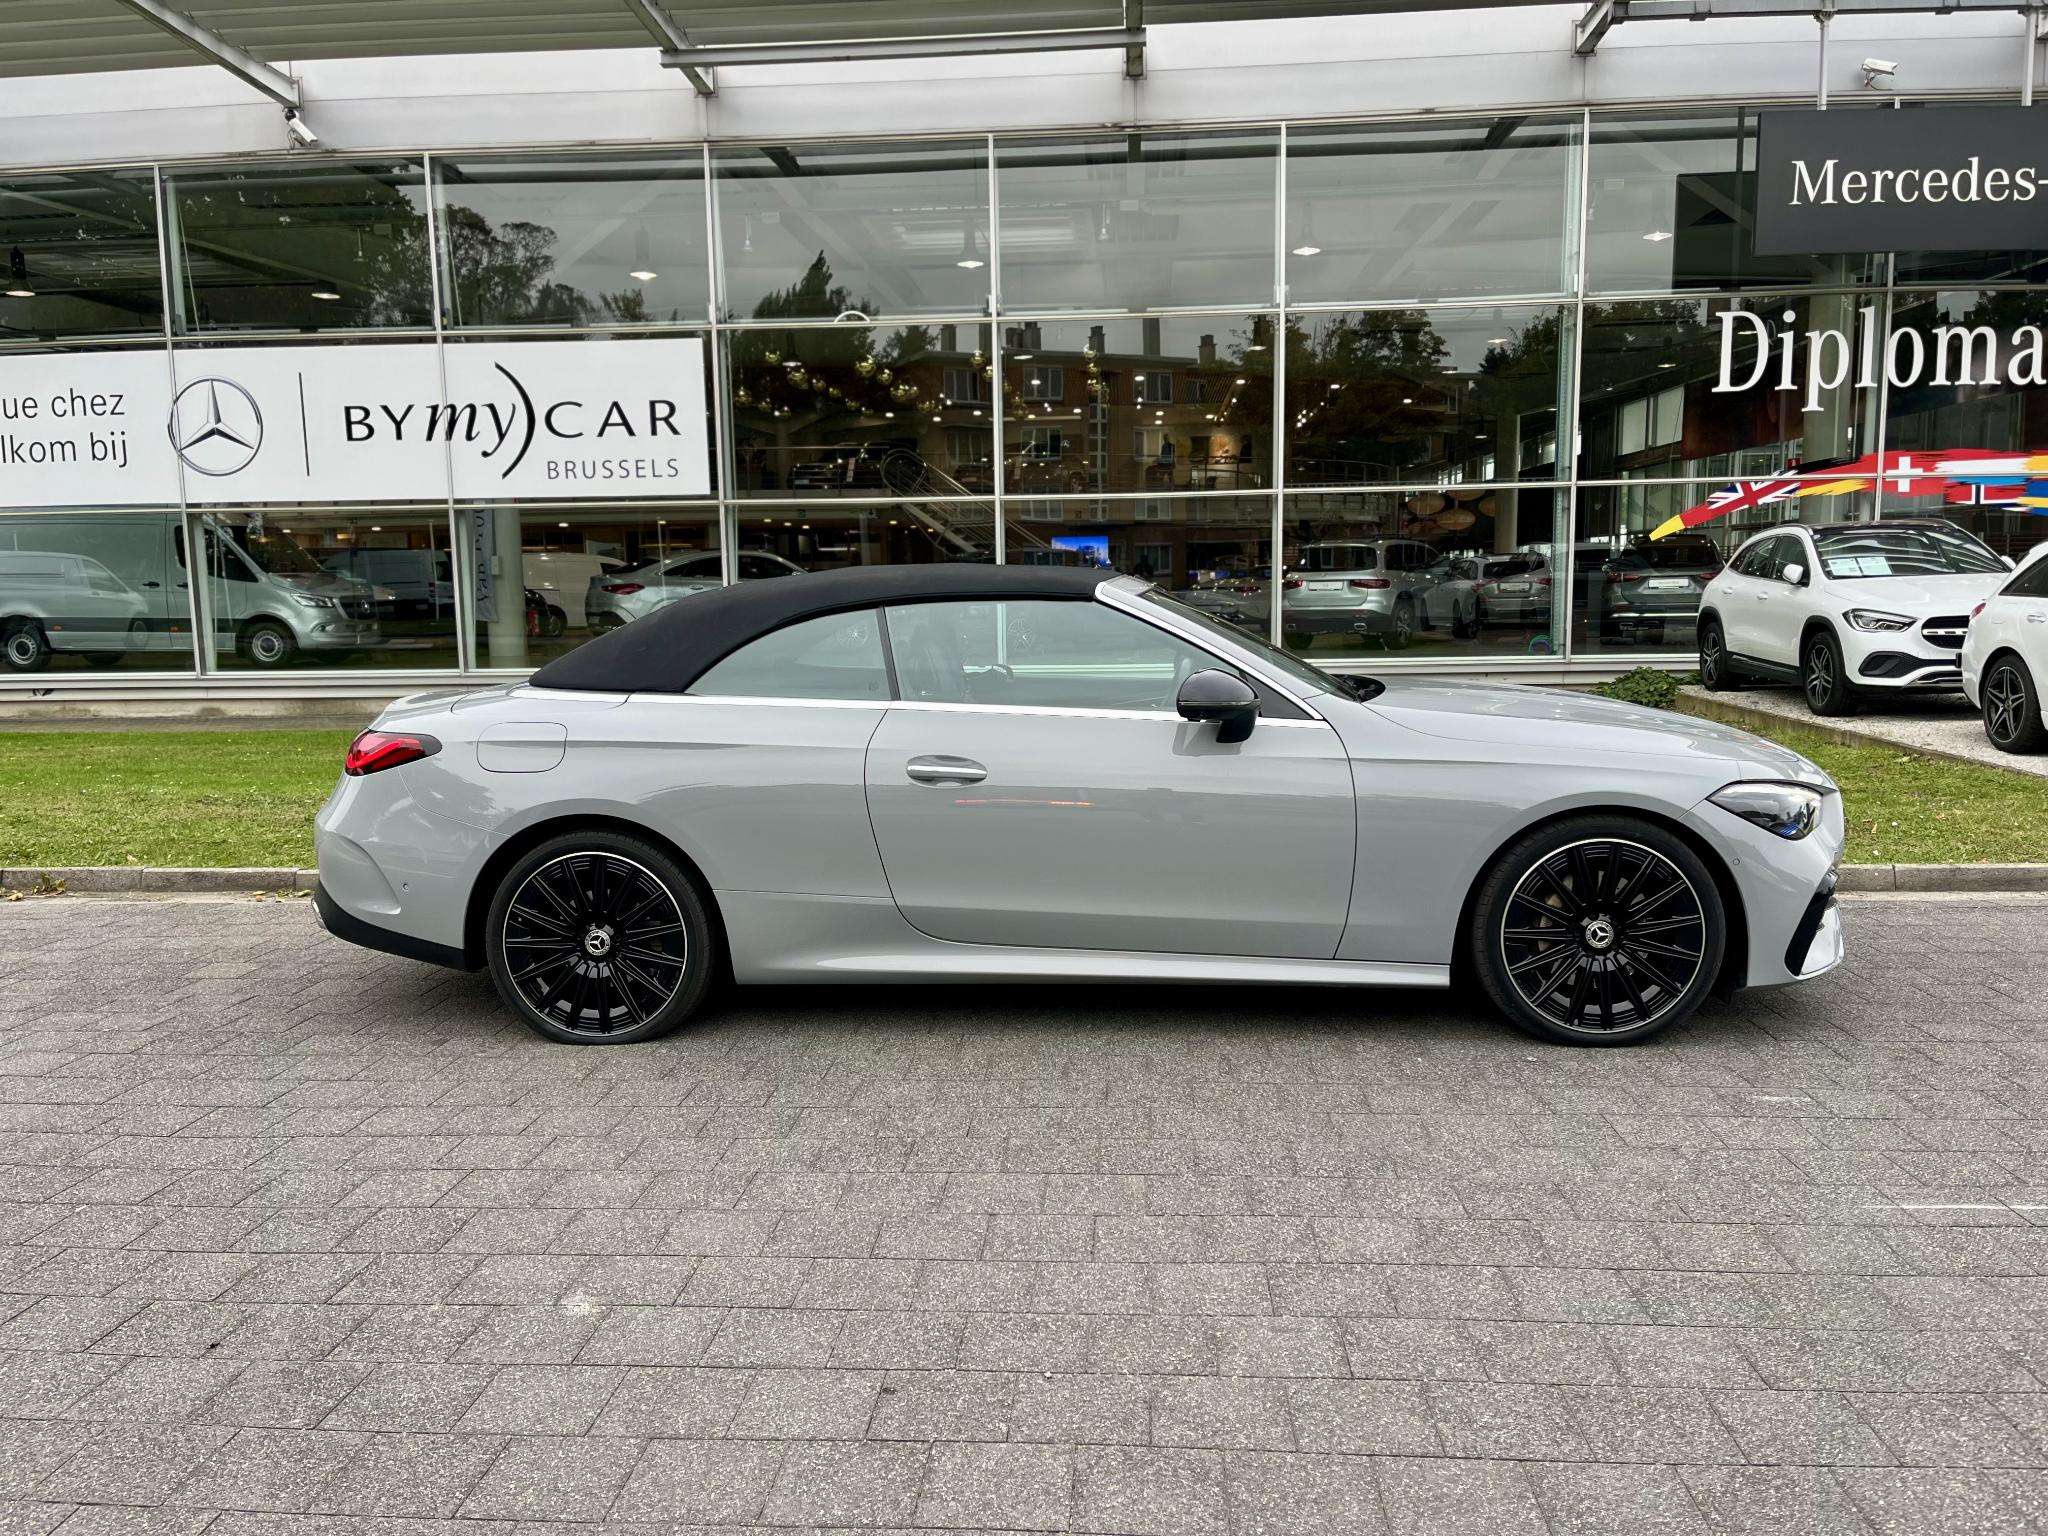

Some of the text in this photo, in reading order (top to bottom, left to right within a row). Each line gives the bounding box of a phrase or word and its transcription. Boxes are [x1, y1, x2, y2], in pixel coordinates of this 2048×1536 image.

[1711, 305, 2048, 413] Diploma
[51, 387, 125, 418] chez
[0, 430, 127, 468] lkom bij
[547, 457, 679, 480] BRUSSELS
